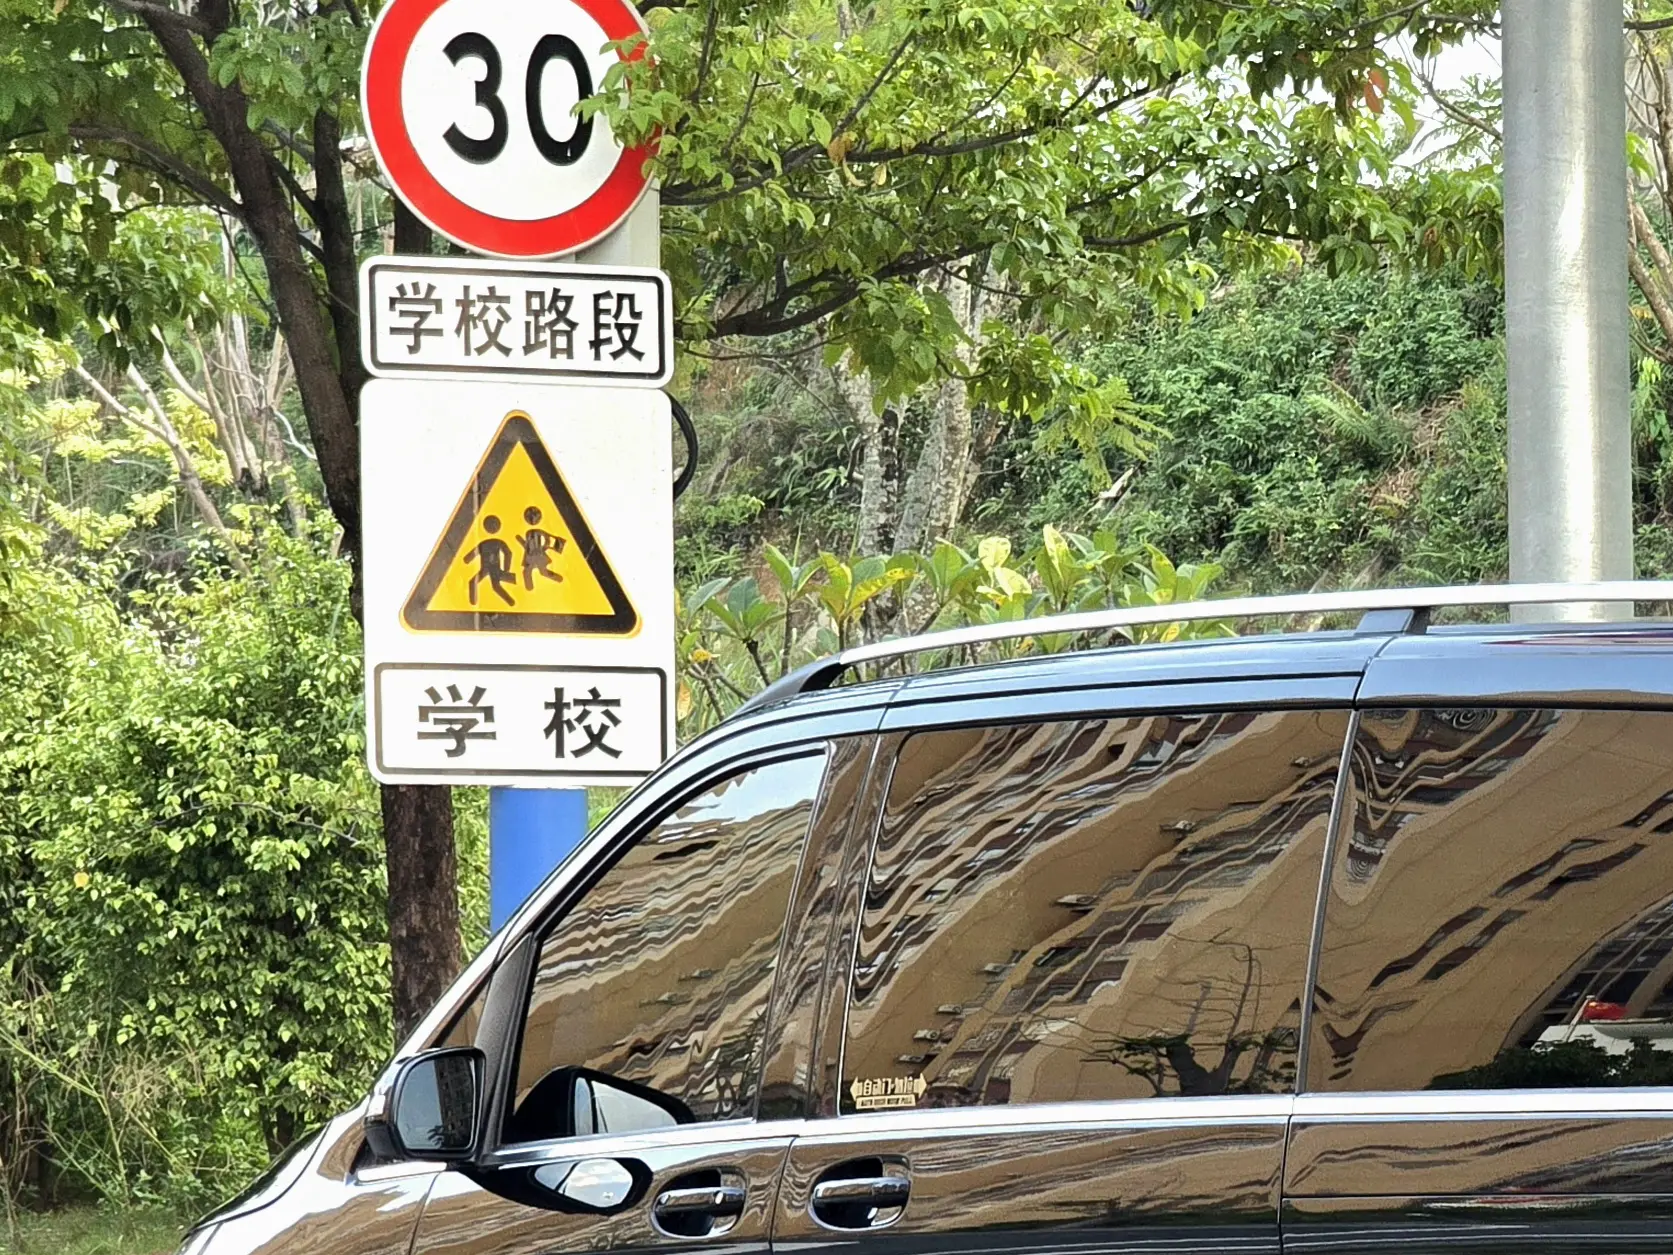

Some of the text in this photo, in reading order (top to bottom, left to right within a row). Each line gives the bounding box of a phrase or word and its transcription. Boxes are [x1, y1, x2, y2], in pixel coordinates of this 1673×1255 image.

[442, 32, 594, 167] 30
[388, 281, 646, 362] 学校路段
[417, 684, 623, 759] 学校
